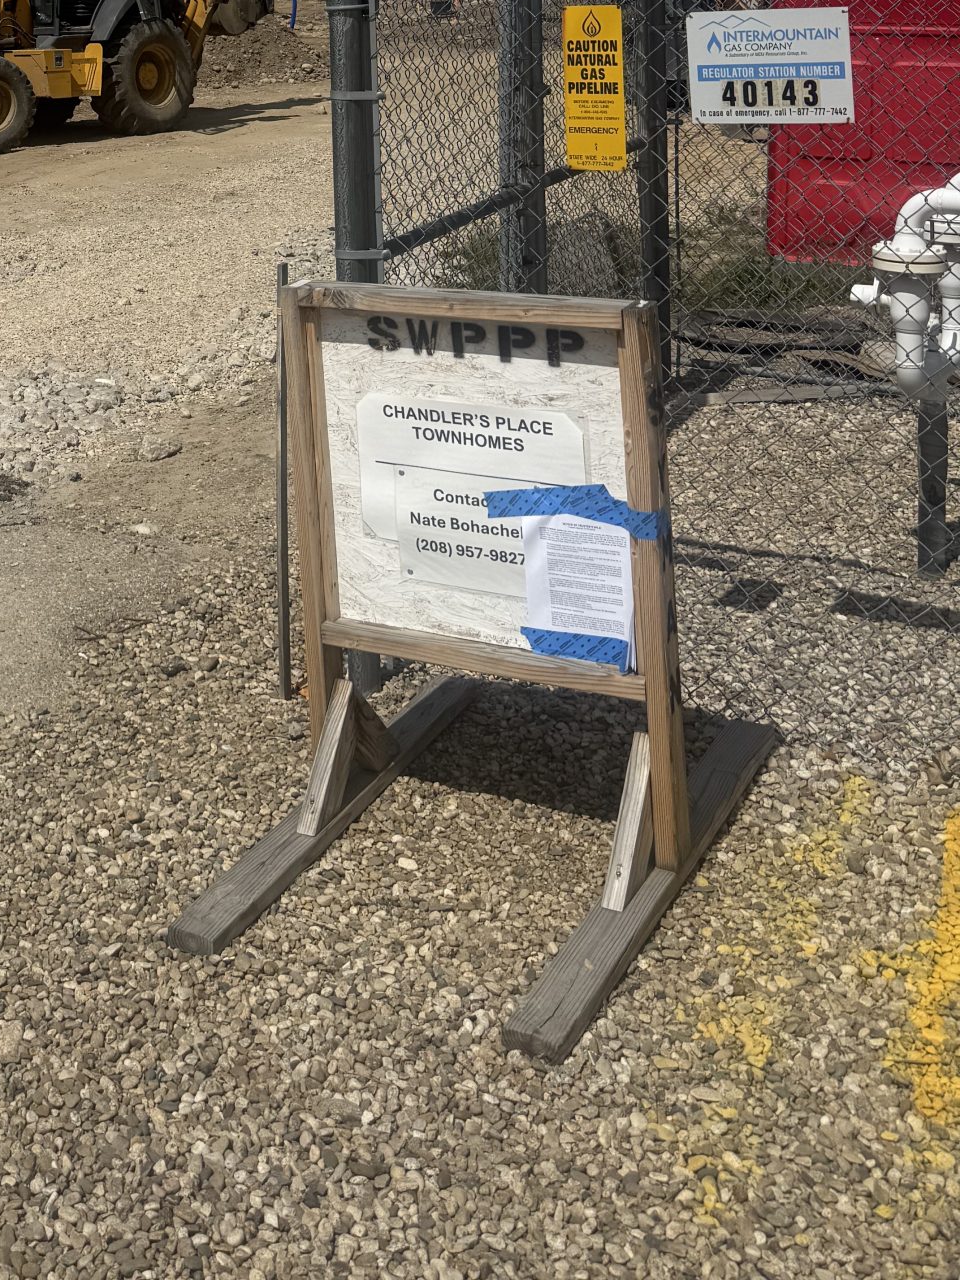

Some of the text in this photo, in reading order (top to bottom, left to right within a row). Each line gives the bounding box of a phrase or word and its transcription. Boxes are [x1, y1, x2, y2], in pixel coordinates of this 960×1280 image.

[723, 27, 840, 43] INTERMOUNTAIN
[567, 39, 618, 53] CAUTION
[723, 42, 793, 52] GAS COMPANY
[567, 54, 618, 67] NATURAL
[580, 67, 606, 81] GAS
[702, 64, 841, 79] REGULATOR STATION NUMBER
[568, 81, 619, 95] PIPELINE
[721, 79, 819, 108] 40143
[699, 109, 708, 117] In
[725, 109, 733, 117] of
[774, 108, 787, 117] call
[789, 107, 848, 117] 1-877-777-7442
[568, 126, 619, 134] EMERGENCY
[366, 315, 585, 368] SWPPP
[383, 404, 554, 436] CHANDLER'S PLACE
[412, 426, 525, 452] TOWNHOMES
[433, 488, 488, 508] Contac
[410, 511, 446, 528] Nate
[450, 517, 524, 540] Bohache
[416, 537, 453, 558] (208)
[456, 544, 526, 566] 957-9827
